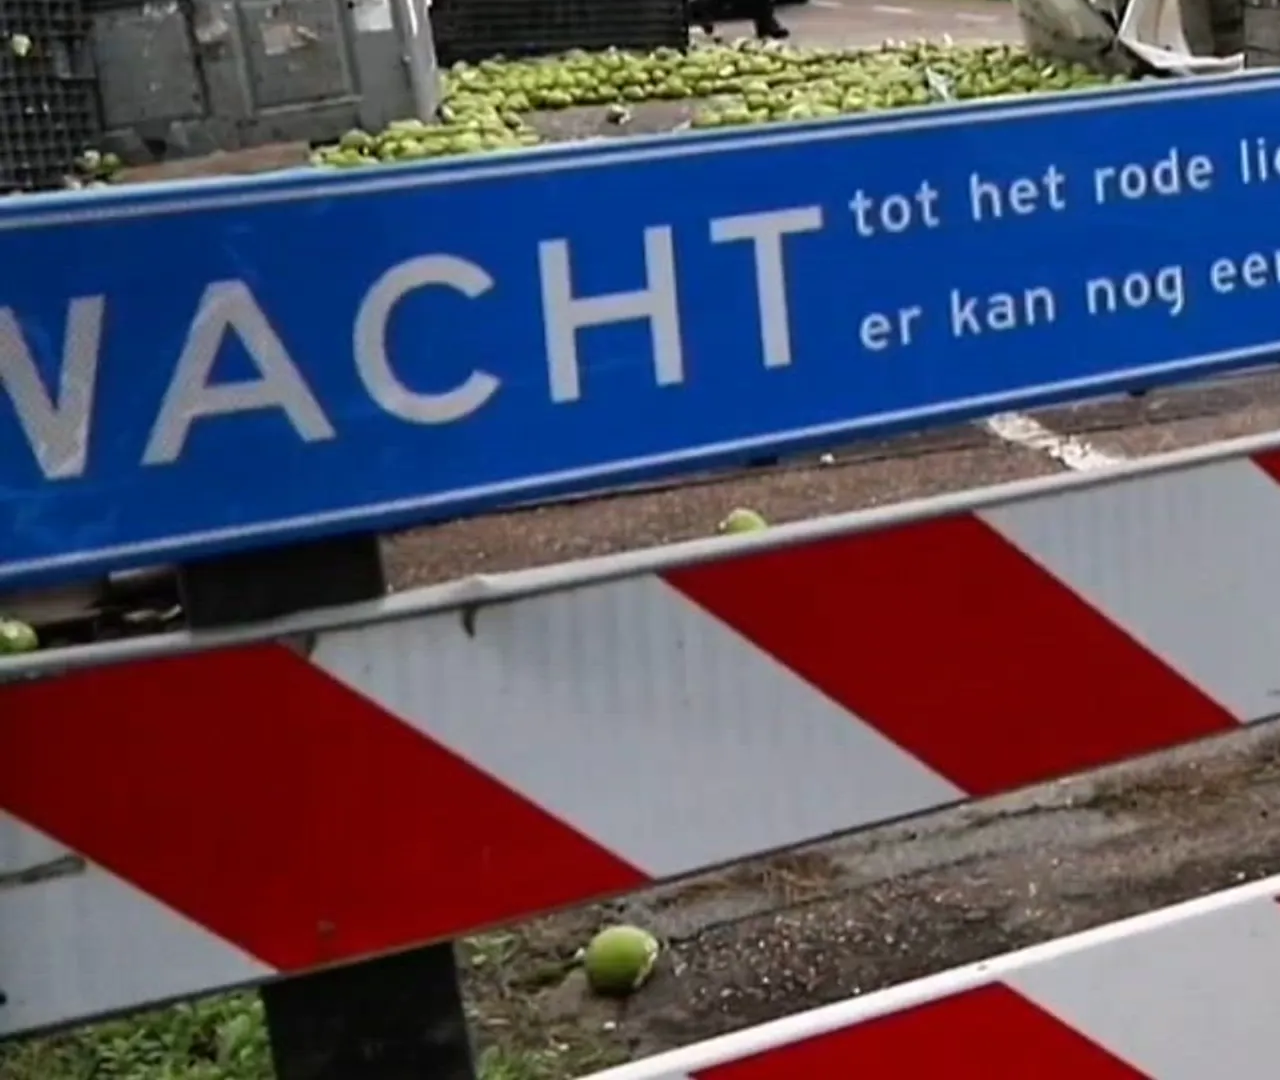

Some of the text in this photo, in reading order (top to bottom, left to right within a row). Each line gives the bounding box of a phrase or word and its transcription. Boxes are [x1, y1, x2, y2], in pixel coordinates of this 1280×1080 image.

[850, 180, 939, 236] tot
[970, 165, 1066, 220] het
[1094, 149, 1213, 203] rode
[860, 307, 922, 350] er
[951, 287, 1055, 338] kan
[1086, 266, 1185, 315] nog
